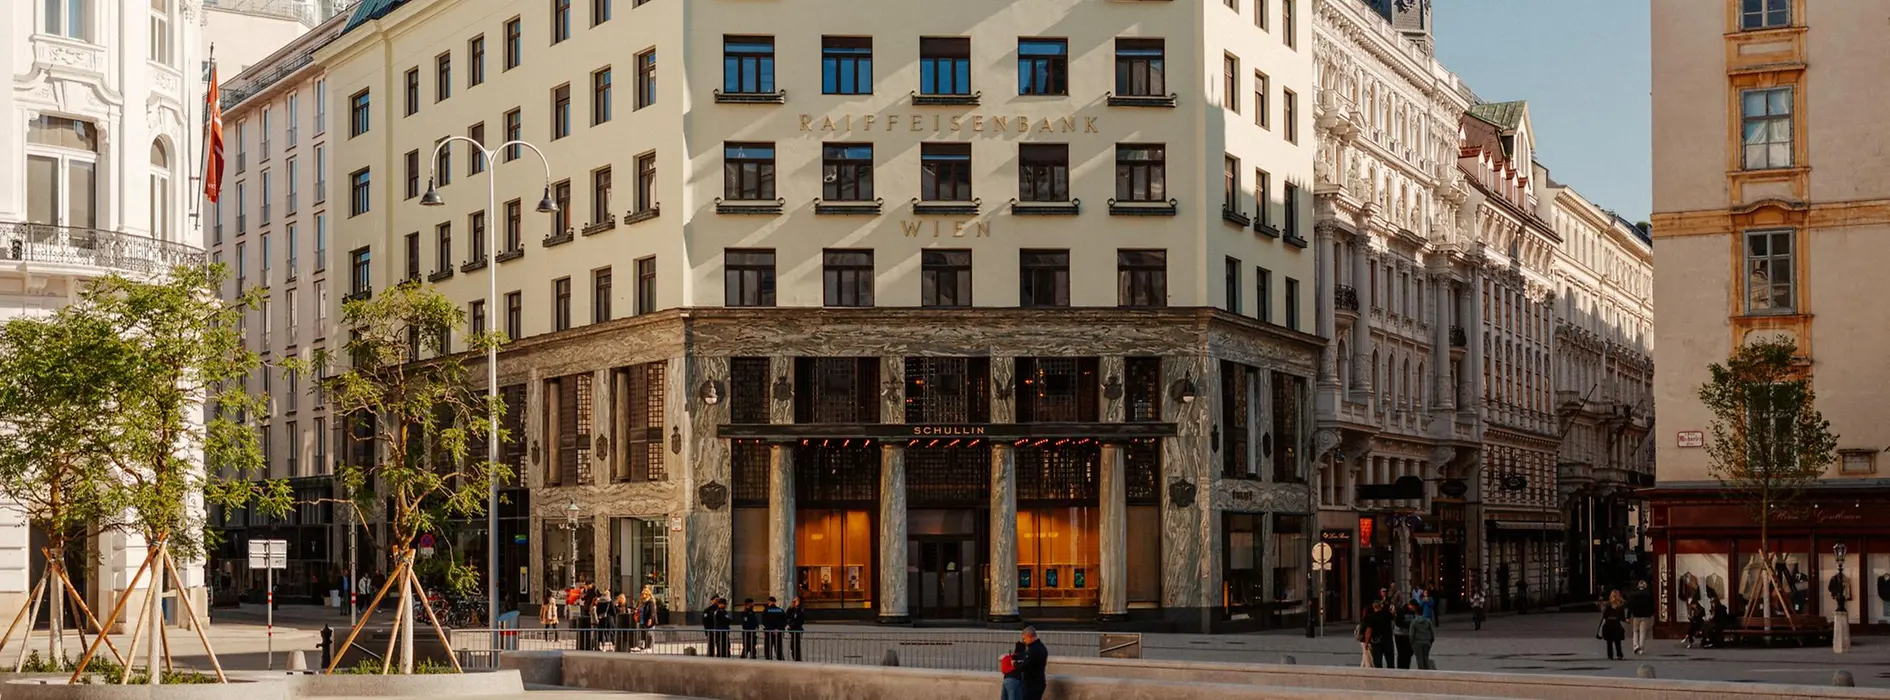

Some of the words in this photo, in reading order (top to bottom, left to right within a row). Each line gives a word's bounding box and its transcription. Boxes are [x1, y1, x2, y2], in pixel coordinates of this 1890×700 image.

[799, 114, 1099, 133] RAIFFEISENBANK
[901, 220, 991, 238] WIEN
[914, 427, 984, 435] SCHULLIN
